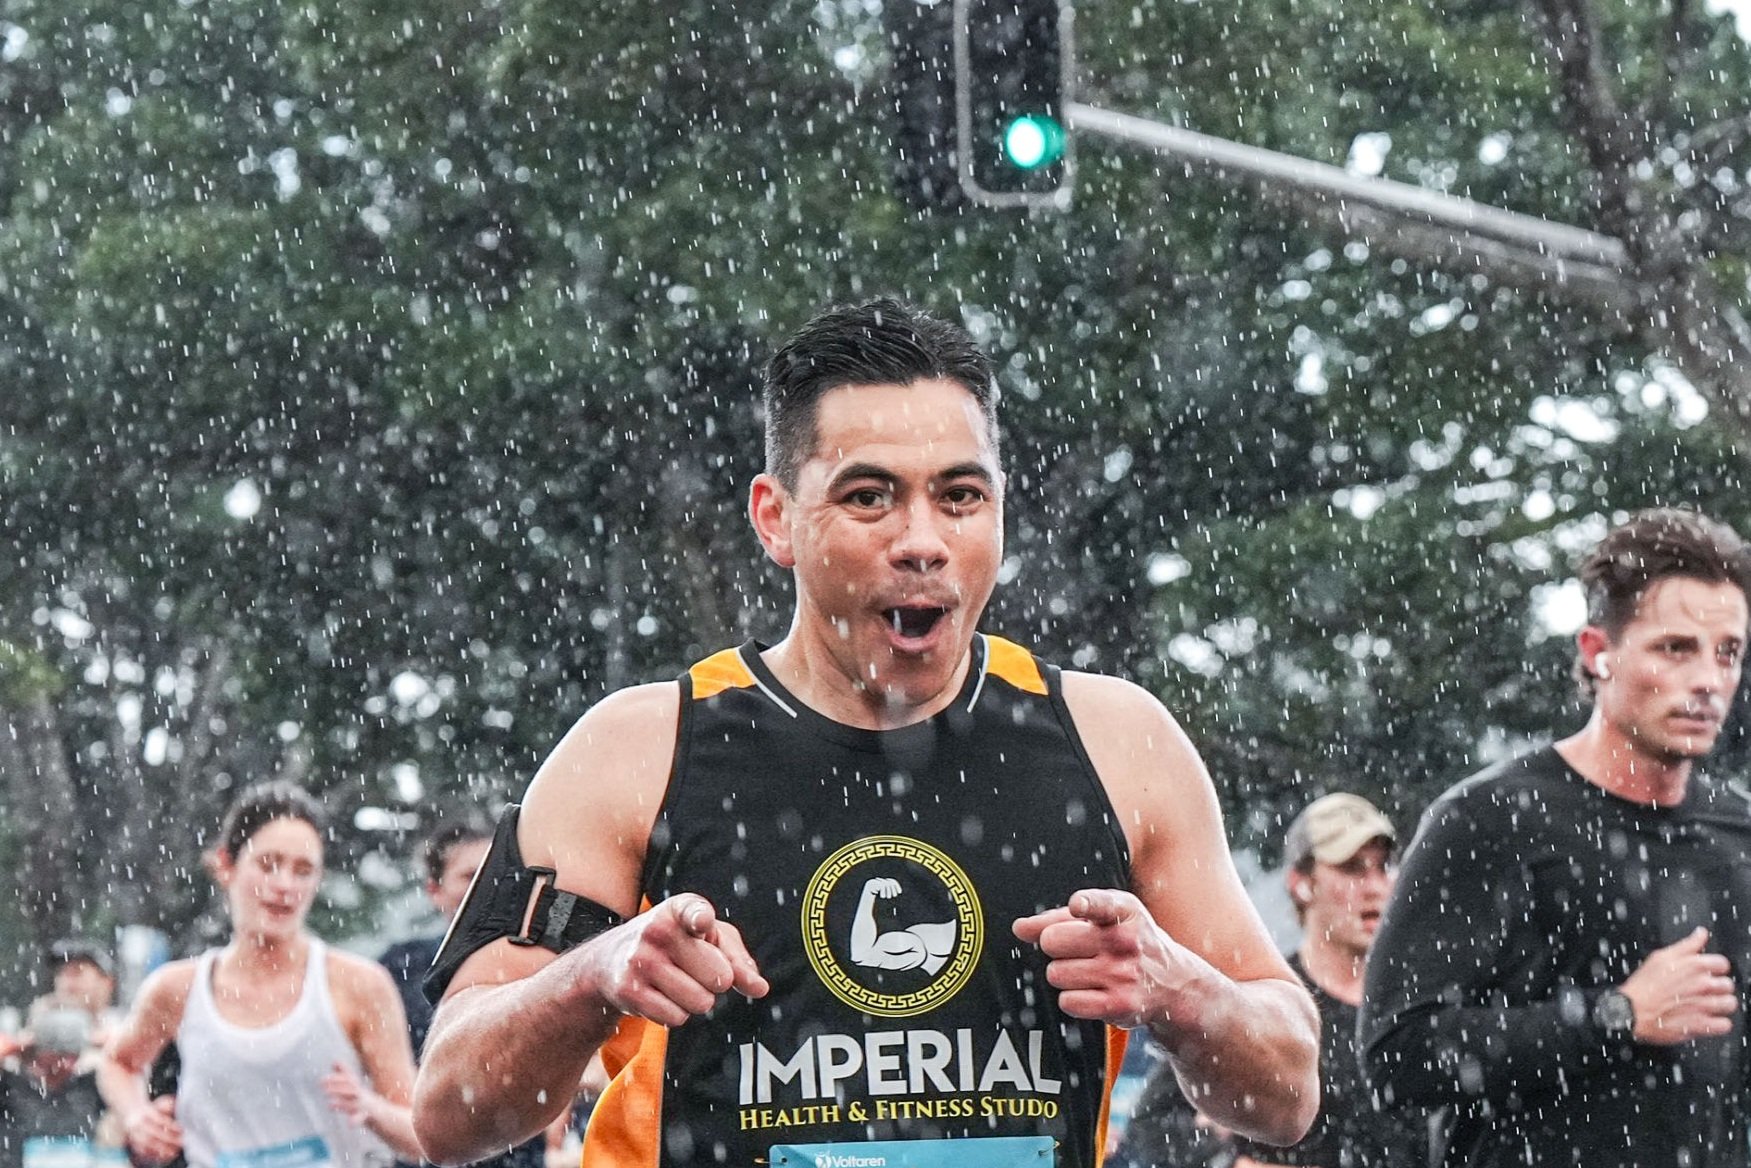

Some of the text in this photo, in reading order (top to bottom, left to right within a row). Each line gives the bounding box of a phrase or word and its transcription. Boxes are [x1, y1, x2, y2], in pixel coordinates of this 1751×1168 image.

[739, 1028, 1062, 1105] IMPERIAL
[739, 1102, 840, 1130] HEALTH
[848, 1101, 869, 1122] &
[876, 1099, 974, 1121] FITNESS
[832, 1154, 886, 1168] Voltaren
